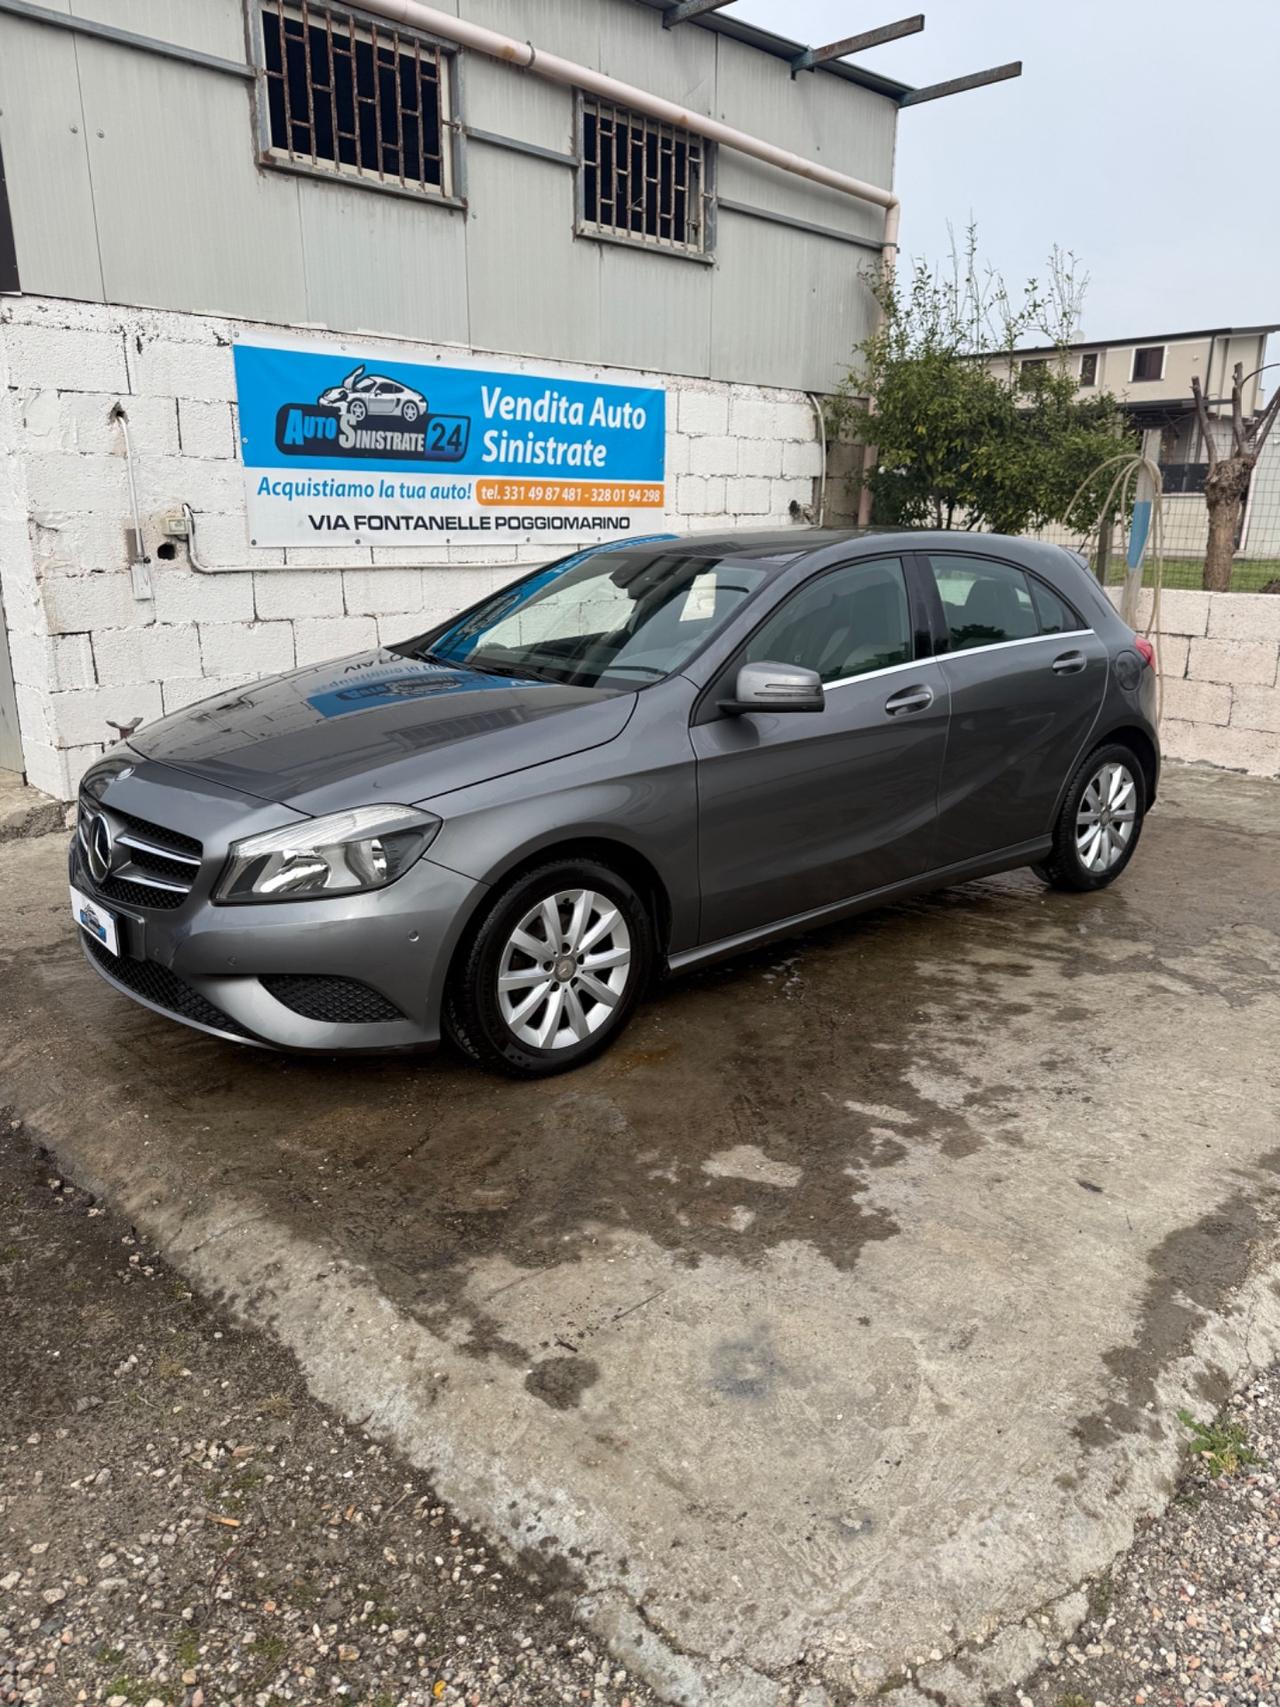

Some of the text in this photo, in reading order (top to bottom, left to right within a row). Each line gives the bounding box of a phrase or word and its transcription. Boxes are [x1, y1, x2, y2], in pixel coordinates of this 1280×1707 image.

[481, 385, 647, 430] Vendita Auto
[431, 422, 463, 451] 24
[481, 429, 607, 467] Sinistrate
[257, 476, 472, 501] Acquistiamo la tua auto!
[481, 484, 500, 500] tel.
[502, 486, 525, 500] 331
[528, 486, 543, 500] 49
[545, 487, 560, 501] 87
[562, 487, 582, 501] 481
[591, 488, 611, 502] 328
[308, 514, 630, 531] VIA FONTANELLE POGGIOMARINO
